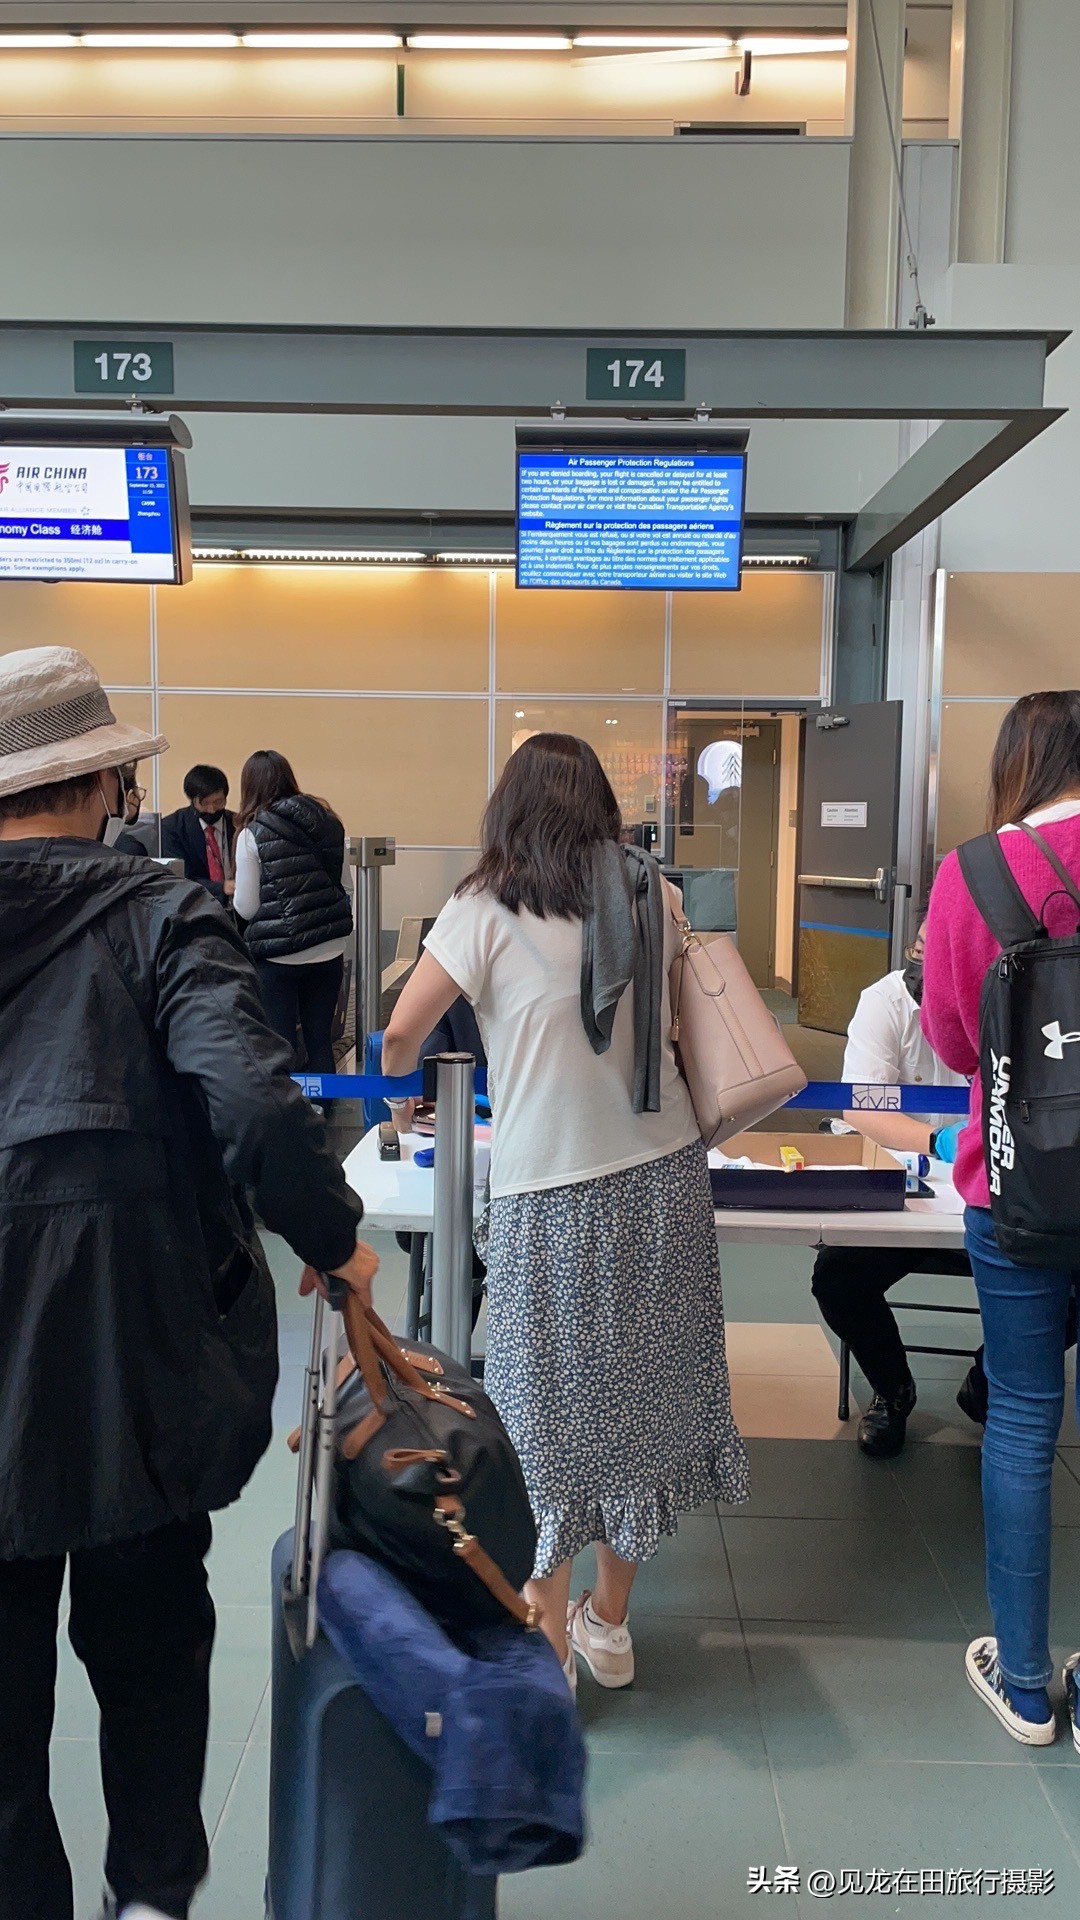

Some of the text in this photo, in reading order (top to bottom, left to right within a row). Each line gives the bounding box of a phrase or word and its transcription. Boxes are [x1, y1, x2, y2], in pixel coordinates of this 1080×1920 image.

[94, 352, 153, 382] 173
[606, 360, 664, 388] 174
[579, 459, 616, 468] Passenger
[654, 459, 694, 468] Regulations
[16, 467, 87, 479] AIR CHINA
[136, 466, 158, 479] 173
[30, 524, 61, 535] Class
[70, 524, 102, 536] 经济舱
[545, 522, 582, 530] Règlement
[603, 522, 637, 530] protection
[852, 1094, 899, 1110] YVR
